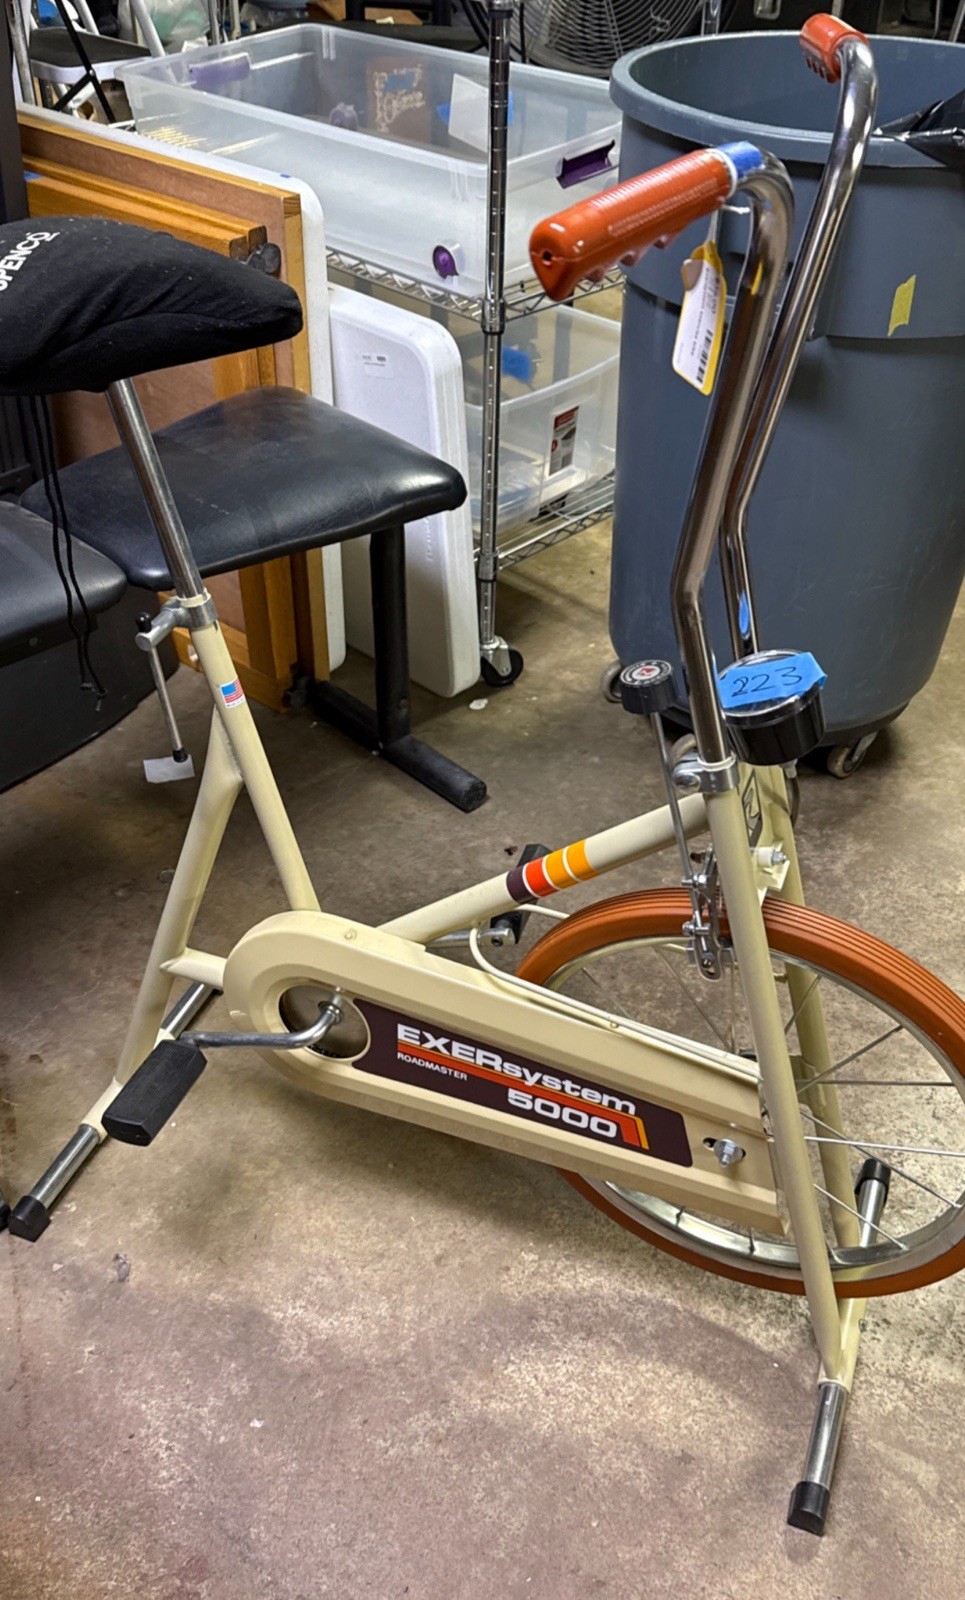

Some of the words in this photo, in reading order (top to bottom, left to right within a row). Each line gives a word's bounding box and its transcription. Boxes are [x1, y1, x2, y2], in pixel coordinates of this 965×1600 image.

[731, 666, 803, 697] 223
[397, 1052, 468, 1081] ROADMASTER
[397, 1023, 637, 1116] EXERsystem
[507, 1088, 618, 1138] 5000
